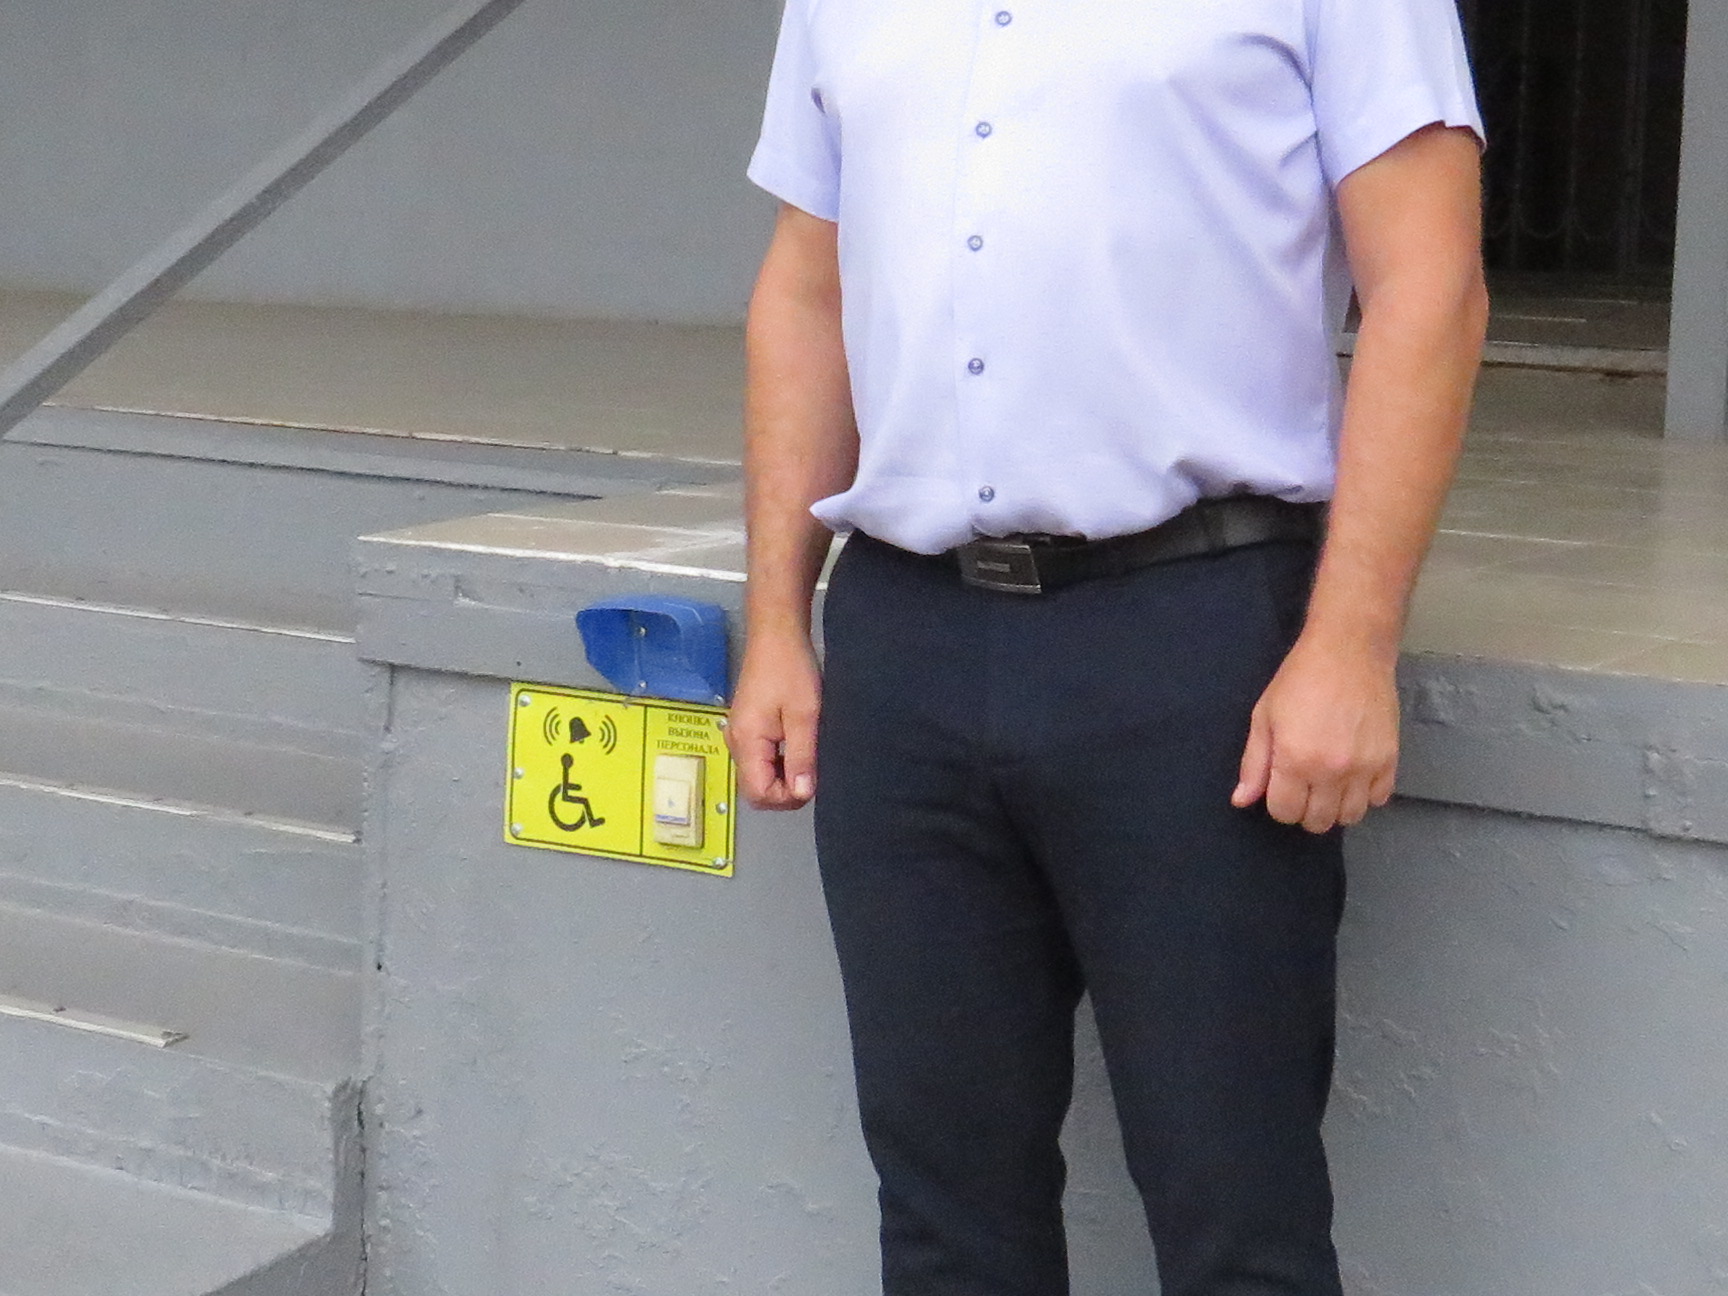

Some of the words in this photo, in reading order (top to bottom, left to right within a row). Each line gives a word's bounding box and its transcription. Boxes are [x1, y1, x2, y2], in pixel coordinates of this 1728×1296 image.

[667, 712, 711, 727] КНОПКА
[667, 726, 710, 740] ВЫЗОВА
[656, 739, 720, 755] ПЕРСОНАЛА
